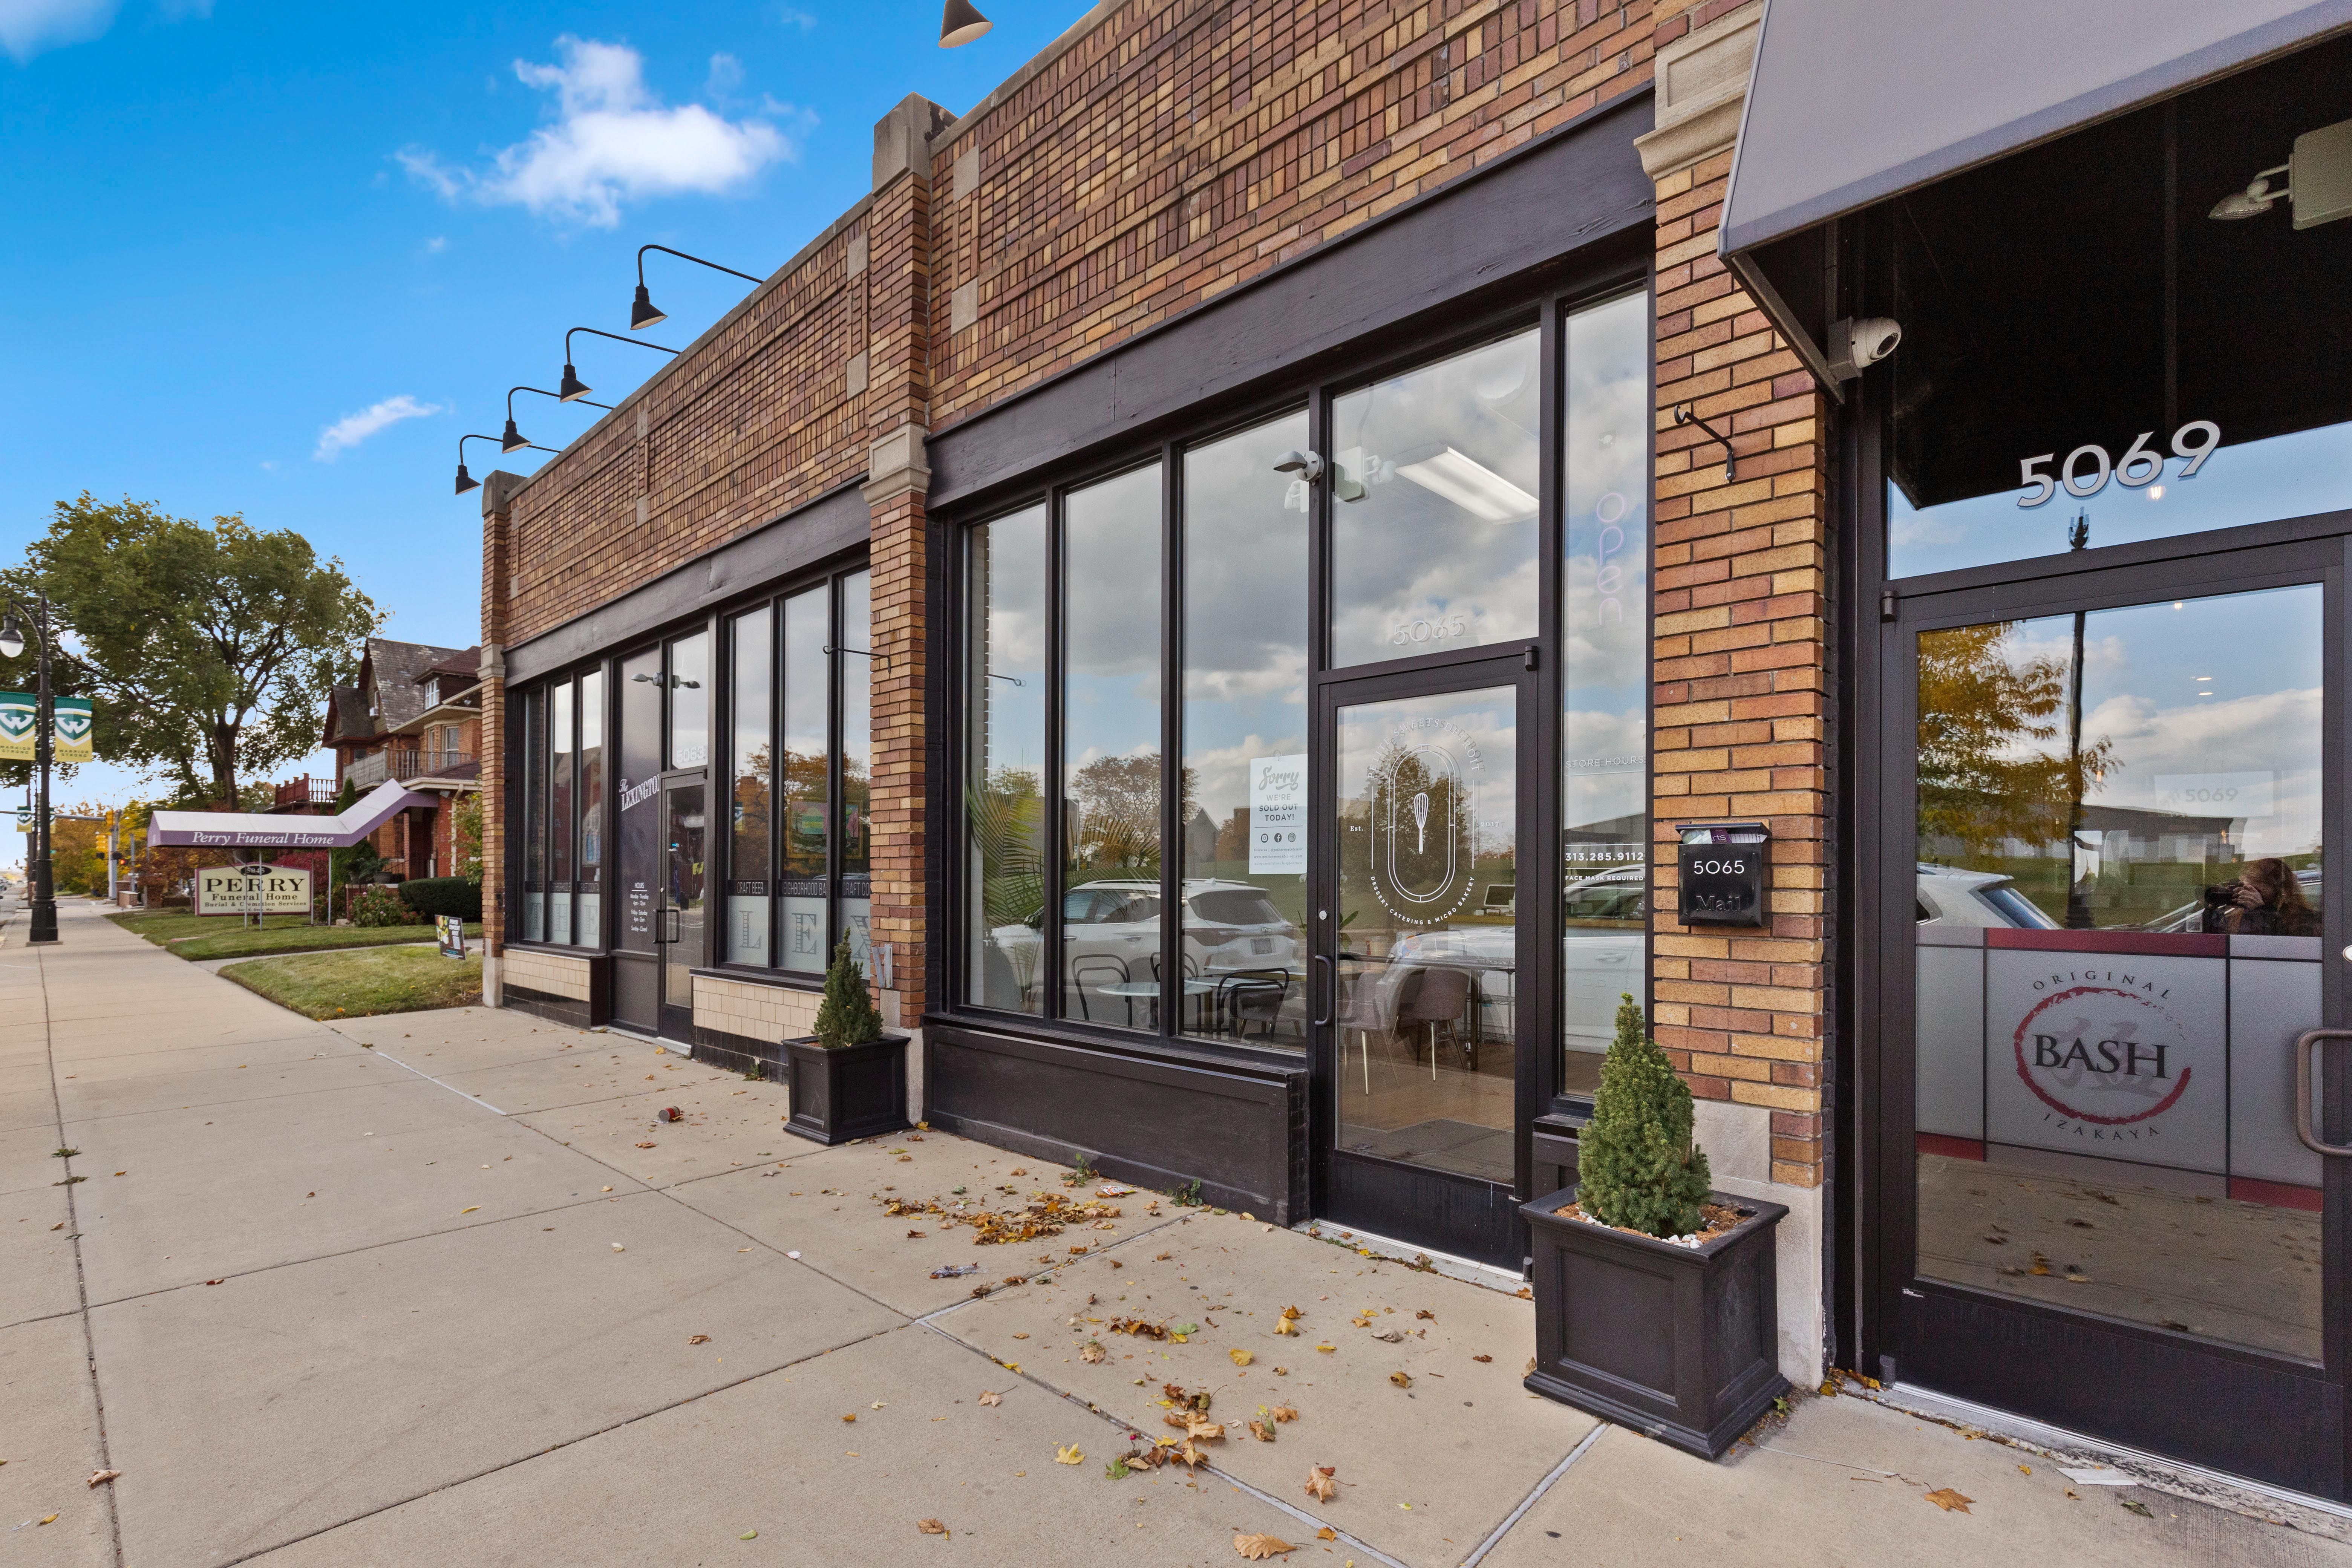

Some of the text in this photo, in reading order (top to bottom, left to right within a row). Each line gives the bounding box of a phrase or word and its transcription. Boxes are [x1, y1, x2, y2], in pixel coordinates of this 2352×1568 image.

[2017, 420, 2221, 507] 5069
[1393, 614, 1461, 645] 5065
[677, 745, 704, 763] 5063
[1368, 718, 1480, 779] PETITE SWEETS DETROIT
[1566, 756, 1644, 768] STORE HOURS
[619, 779, 628, 793] The
[1259, 766, 1299, 791] Sorry
[2185, 787, 2239, 802] 5069
[192, 831, 334, 845] Perry Funeral Home
[1565, 852, 1644, 861] 313.285.9112
[1694, 860, 1744, 874] 5065
[204, 878, 305, 892] PERRY
[737, 882, 763, 894] CRAFT BEER
[1370, 876, 1389, 907] DESSERT
[1389, 908, 1424, 925] CATERING
[1435, 907, 1457, 923] MICRO
[1458, 876, 1475, 906] BAKERY
[1696, 895, 1741, 911] Mail
[2033, 971, 2171, 999] ORIGINAL
[2032, 1034, 2171, 1079] BASH
[2044, 1113, 2159, 1141] IZAKAYA
